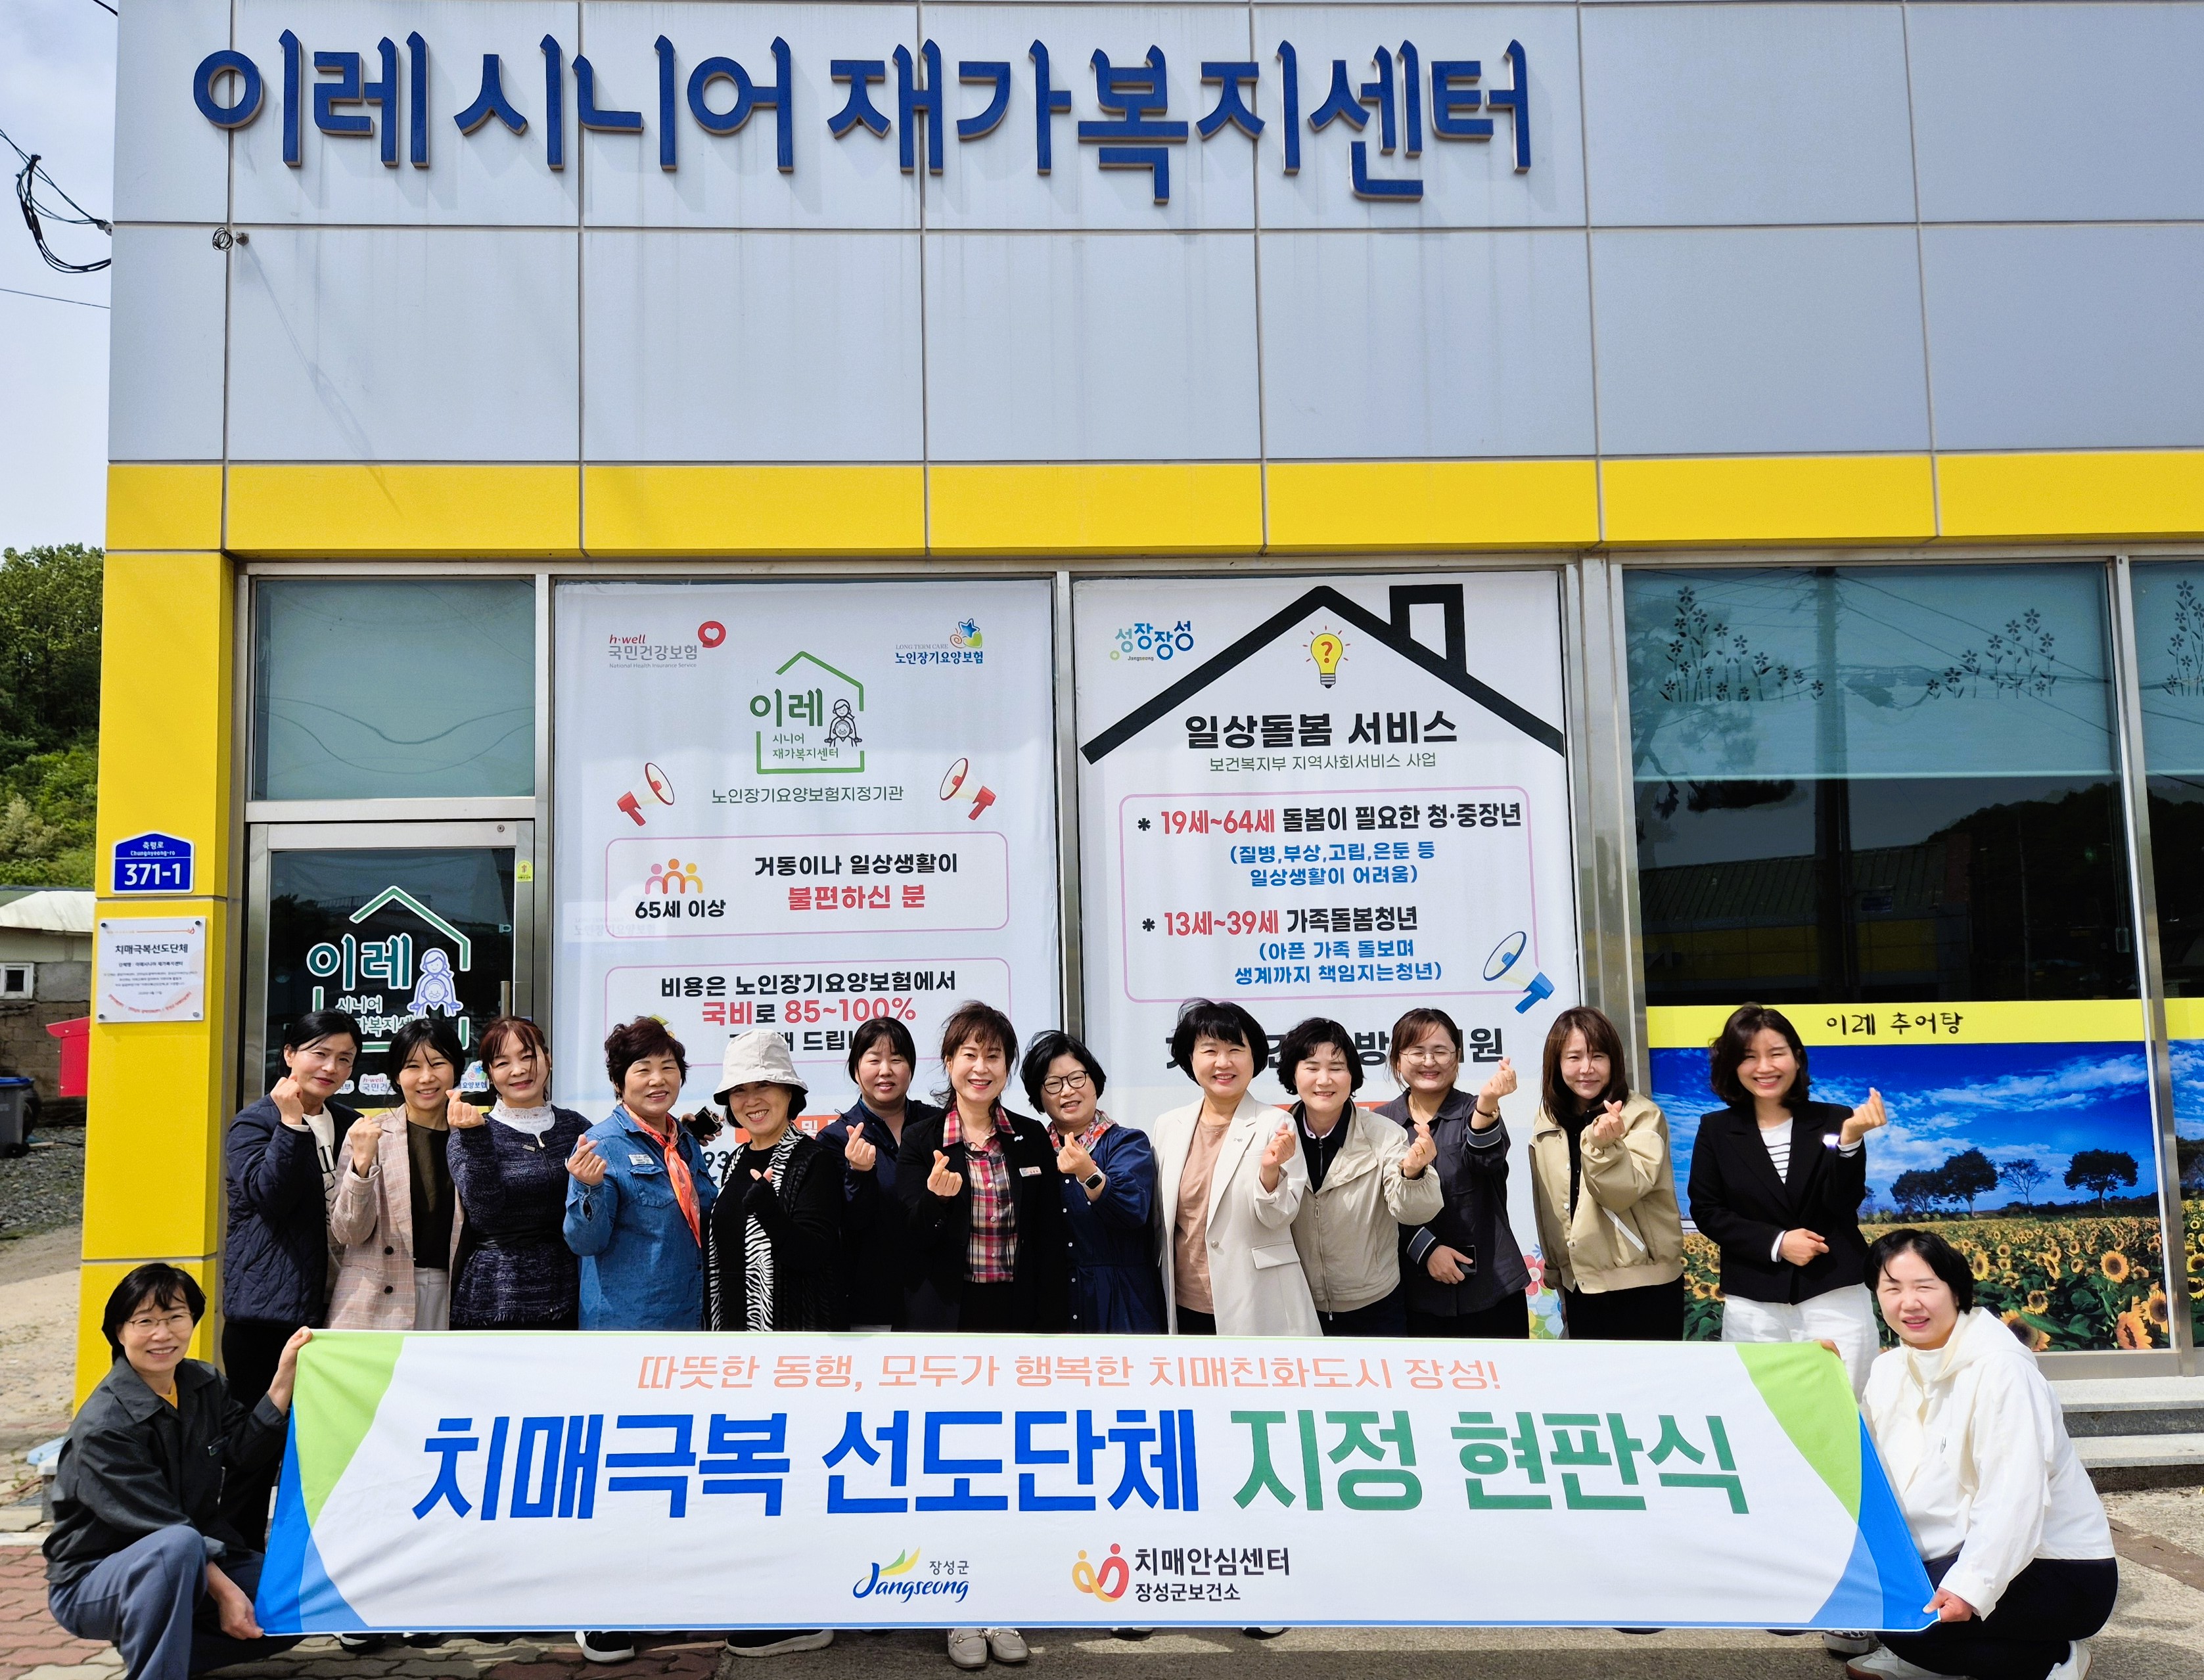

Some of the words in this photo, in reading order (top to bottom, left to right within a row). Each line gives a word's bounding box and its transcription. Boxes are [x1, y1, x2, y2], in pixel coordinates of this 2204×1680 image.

[193, 28, 430, 169] 이레
[454, 34, 794, 173] 시니어
[827, 38, 1531, 204] 재가복지센터
[1115, 620, 1194, 661] 성장장성
[608, 645, 697, 661] 국민건강보험
[895, 651, 984, 665] 노인장기요양보험
[750, 688, 823, 728] 이레
[772, 733, 806, 745] 시니어
[1183, 714, 1333, 749] 일상돌봄
[1348, 710, 1458, 745] 서비스
[772, 747, 839, 761] 재가복지센터
[1209, 755, 1287, 773] 보건복지부
[1292, 753, 1401, 771] 지역사회서비스
[1406, 752, 1436, 769] 사업
[712, 786, 904, 804] 노인장기요양보험지정기관
[1160, 807, 1275, 835] 19세~64세
[1282, 806, 1348, 833] 돌봄이
[1355, 805, 1421, 831] 필요한
[1427, 802, 1522, 830] 청·중장년
[1417, 841, 1435, 860] 등
[124, 863, 181, 886] 371-1
[754, 855, 842, 876] 거동이나
[850, 853, 958, 875] 일상생활이
[1250, 867, 1346, 887] 일상생활이
[1352, 864, 1418, 884] 어려움)
[635, 900, 681, 919] 65세
[687, 899, 727, 919] 이상
[788, 884, 891, 911] 불편하신
[902, 884, 926, 909] 분
[1164, 909, 1279, 936] 13세~39세
[1287, 905, 1418, 934] 가족돌봄청년
[115, 943, 189, 955] 치매극복선도단체
[1259, 942, 1310, 962] (아픈
[1314, 941, 1350, 960] 가족
[1358, 940, 1414, 959] 돌보며
[307, 933, 413, 990] 이레
[661, 976, 726, 997] 비용은
[735, 970, 956, 995] 노인장기요양보험에서
[1234, 965, 1311, 986] 생계까지
[1318, 961, 1442, 983] 책임지는청년)
[336, 995, 383, 1014] 시니어
[702, 1000, 776, 1026] 국비로
[785, 997, 917, 1024] 85~100%
[1826, 1012, 1876, 1036] 이레
[1890, 1012, 1964, 1035] 추어탕
[803, 1030, 854, 1051] 드립
[362, 1083, 393, 1092] 국민건
[637, 1354, 760, 1390] 따뜻한
[773, 1355, 865, 1392] 동행,
[879, 1355, 1001, 1388] 모두가
[1015, 1355, 1134, 1387] 행복한
[1149, 1355, 1393, 1390] 치매친화도시
[1404, 1358, 1502, 1390] 장성!
[411, 1413, 791, 1521] 치매극복
[821, 1409, 1199, 1514] 선도단체
[1230, 1409, 1423, 1512] 지정
[1451, 1411, 1750, 1514] 현판식
[929, 1560, 970, 1576] 장성군
[1135, 1547, 1291, 1577] 치매안심센터
[852, 1561, 969, 1603] Jangseong
[1135, 1582, 1241, 1602] 장성군보건소
